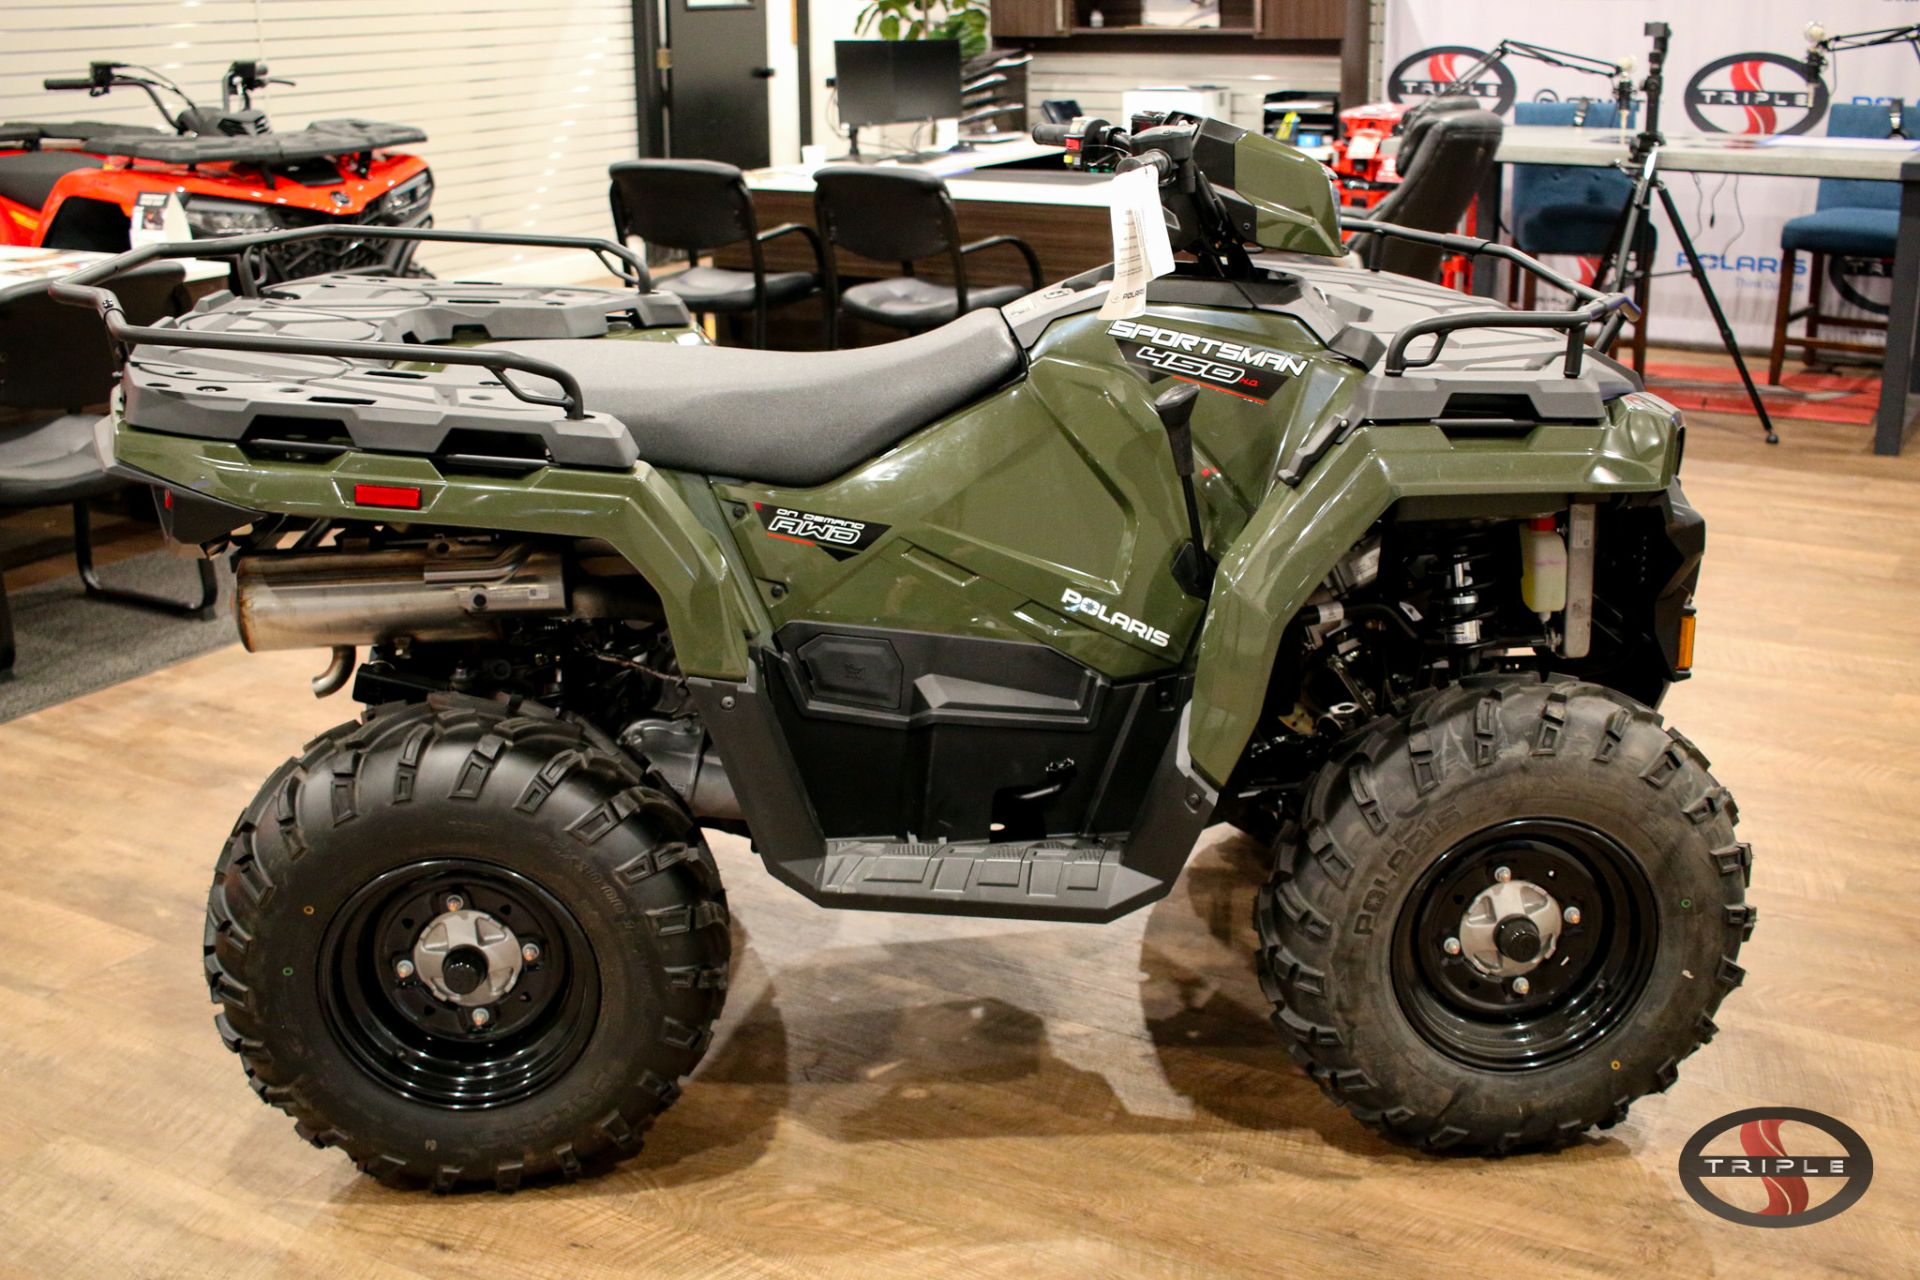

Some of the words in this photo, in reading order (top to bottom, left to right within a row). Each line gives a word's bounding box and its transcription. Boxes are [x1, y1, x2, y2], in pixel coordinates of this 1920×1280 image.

[1402, 81, 1498, 97] TRILE
[1700, 90, 1808, 106] TRIPLE
[1676, 252, 1807, 275] POLARS
[1106, 319, 1310, 377] SPORTSMAN
[1136, 345, 1245, 384] 450
[767, 515, 862, 545] AWD
[802, 513, 866, 531] DEMAND
[1060, 587, 1171, 648] POLARIS
[1353, 803, 1463, 936] POLARIS
